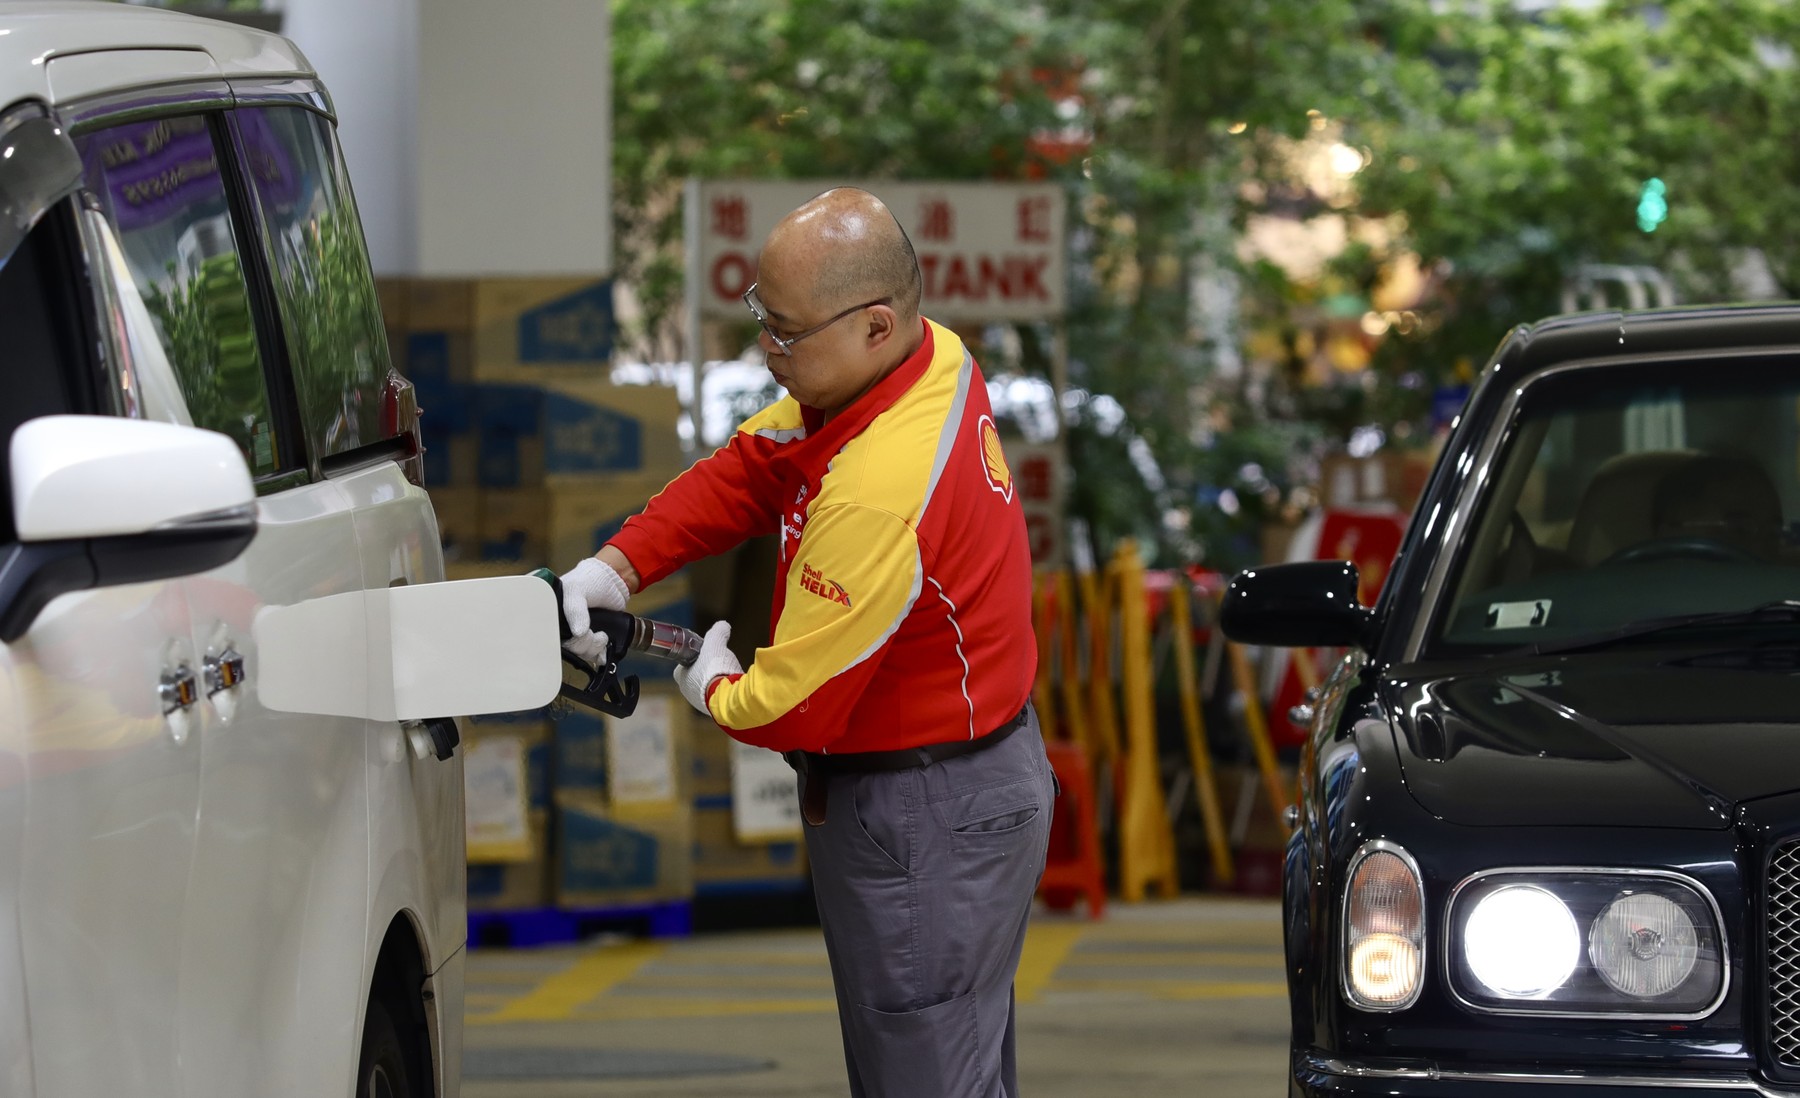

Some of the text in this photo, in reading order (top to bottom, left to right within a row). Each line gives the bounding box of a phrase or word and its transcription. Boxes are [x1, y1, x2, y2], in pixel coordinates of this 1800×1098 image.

[921, 252, 1052, 301] TANK
[800, 572, 850, 606] HELIX
[803, 563, 822, 581] Shell
